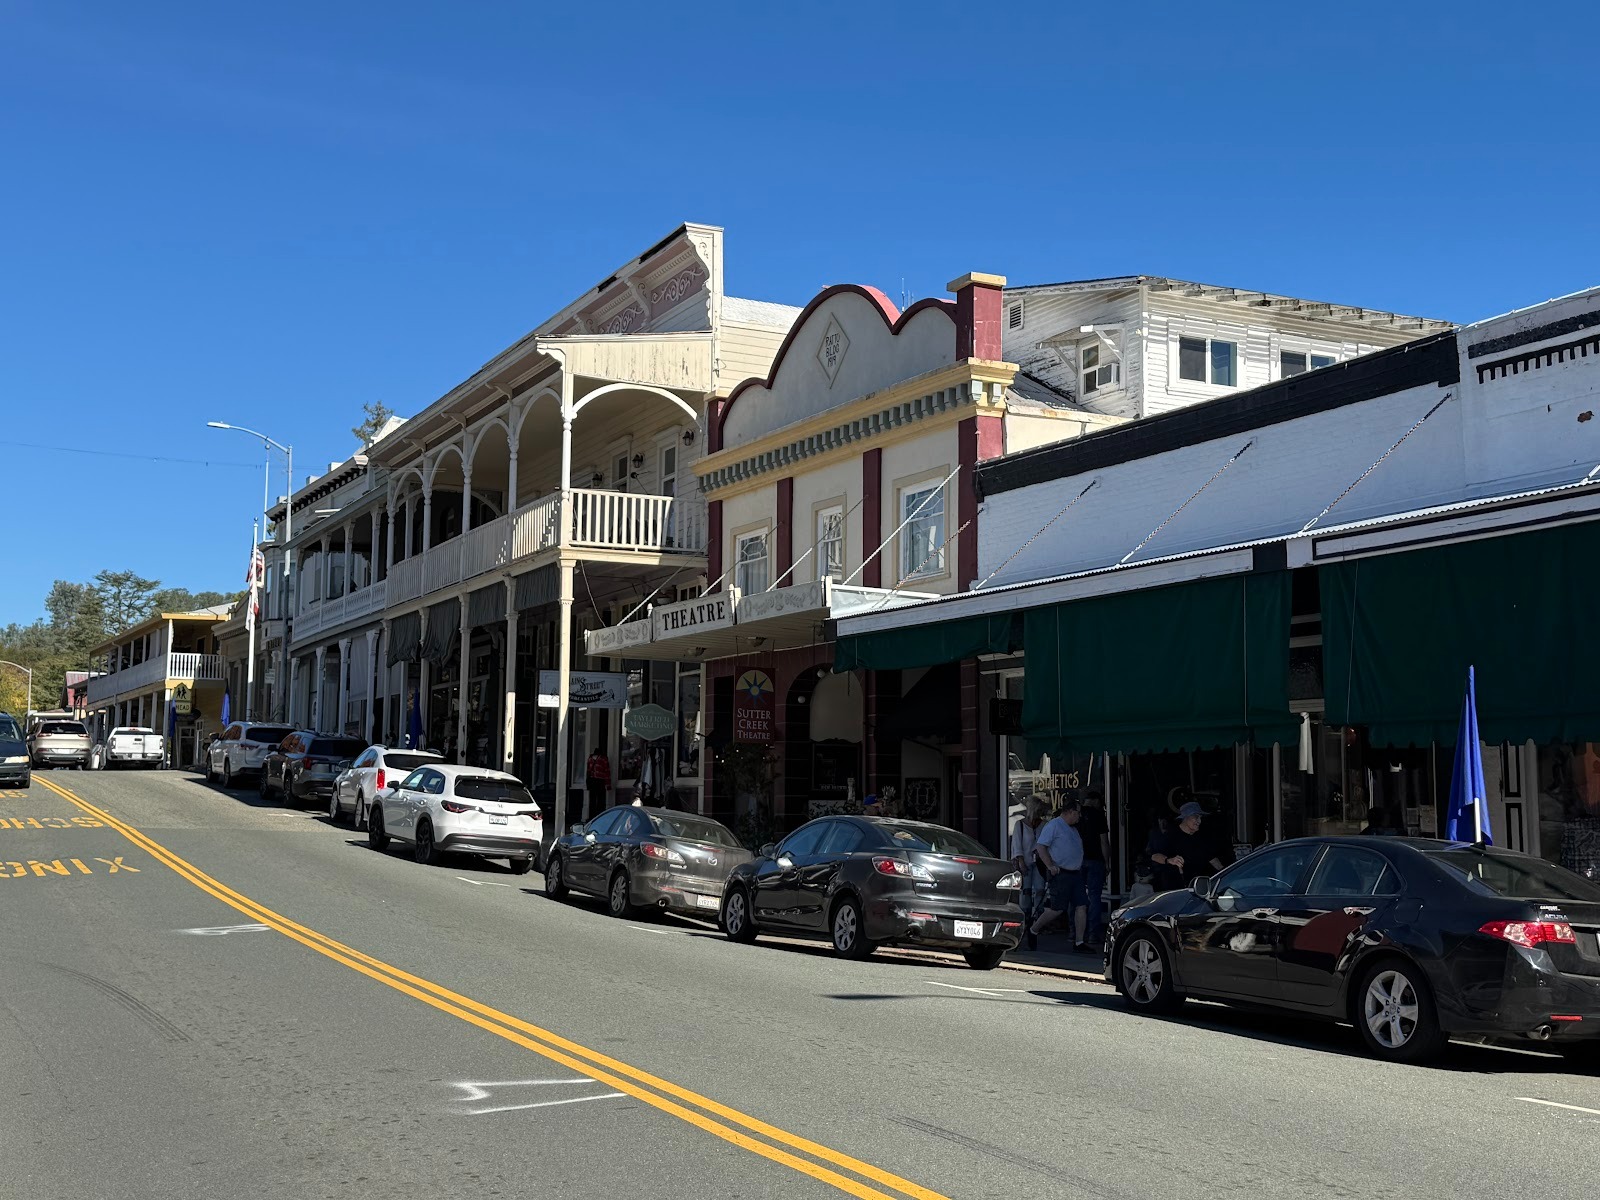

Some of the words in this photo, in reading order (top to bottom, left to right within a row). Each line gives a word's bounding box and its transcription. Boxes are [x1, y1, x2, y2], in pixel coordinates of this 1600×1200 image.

[825, 333, 840, 347] RATTO
[826, 343, 839, 357] BLDG
[828, 355, 836, 367] 1919
[662, 601, 726, 631] THEATRE
[737, 708, 771, 720] SUTTER
[630, 720, 673, 730] MARKETING
[738, 718, 769, 730] CREEK
[737, 730, 771, 740] THEATRE
